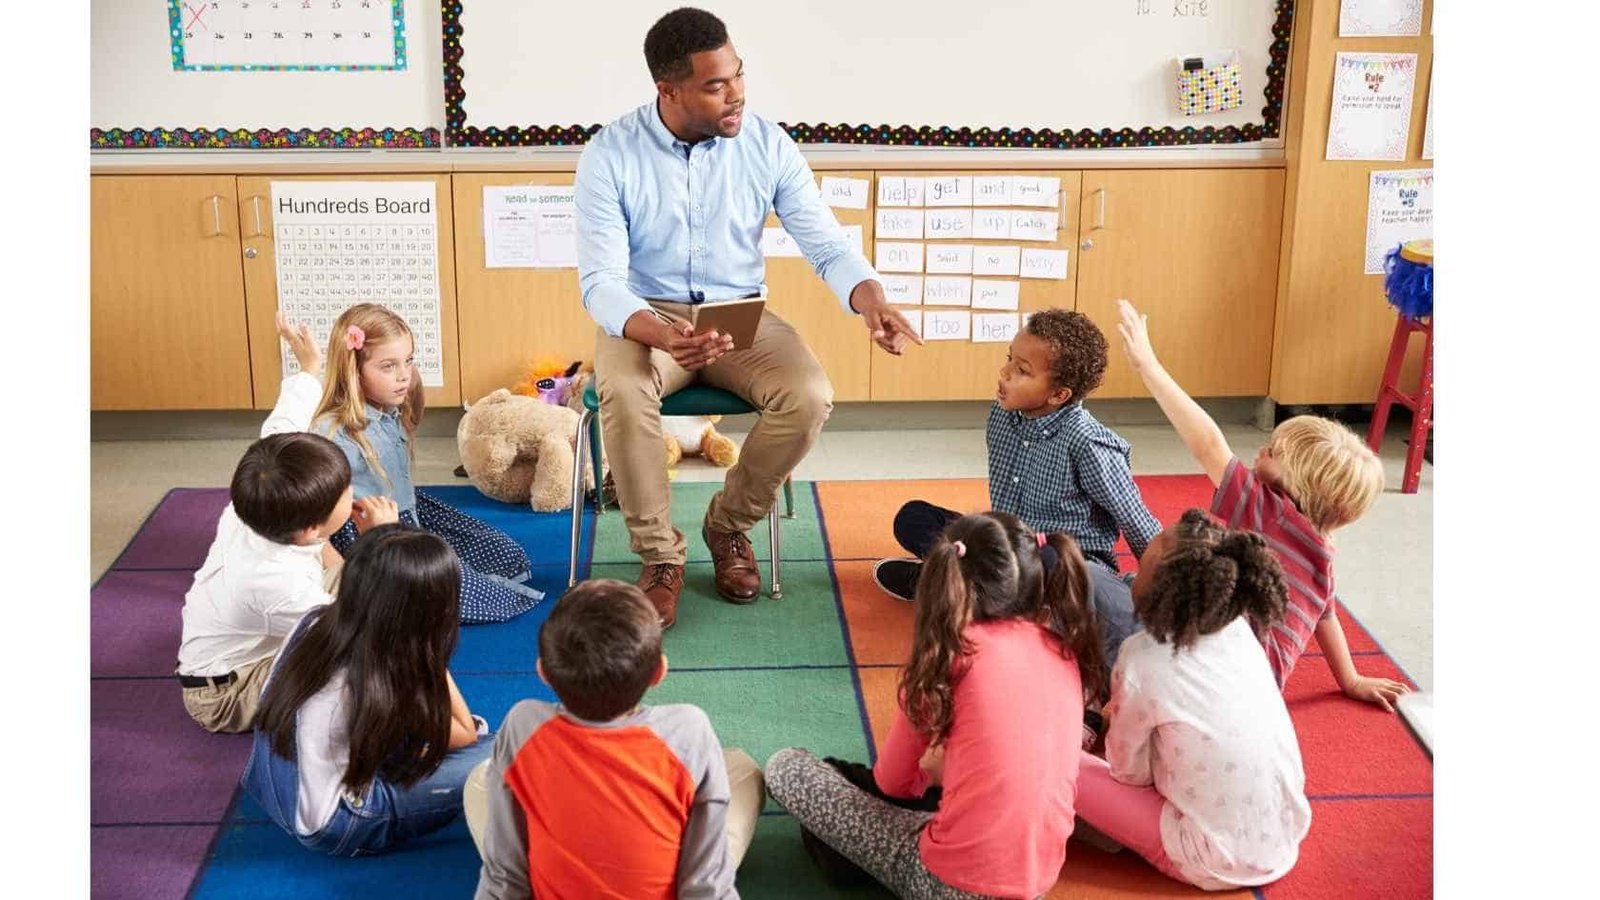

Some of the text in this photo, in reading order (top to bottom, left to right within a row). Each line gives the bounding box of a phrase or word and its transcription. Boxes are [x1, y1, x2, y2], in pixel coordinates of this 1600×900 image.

[1365, 72, 1384, 82] Rule
[882, 178, 1040, 206] help get and good
[1399, 188, 1418, 198] Rule
[279, 198, 430, 214] Hundreds Board
[421, 228, 431, 236] 10
[931, 218, 967, 231] use
[984, 216, 1005, 232] up
[888, 249, 908, 262] on
[937, 253, 959, 262] said
[926, 281, 964, 297] when
[929, 314, 1011, 338] too her
